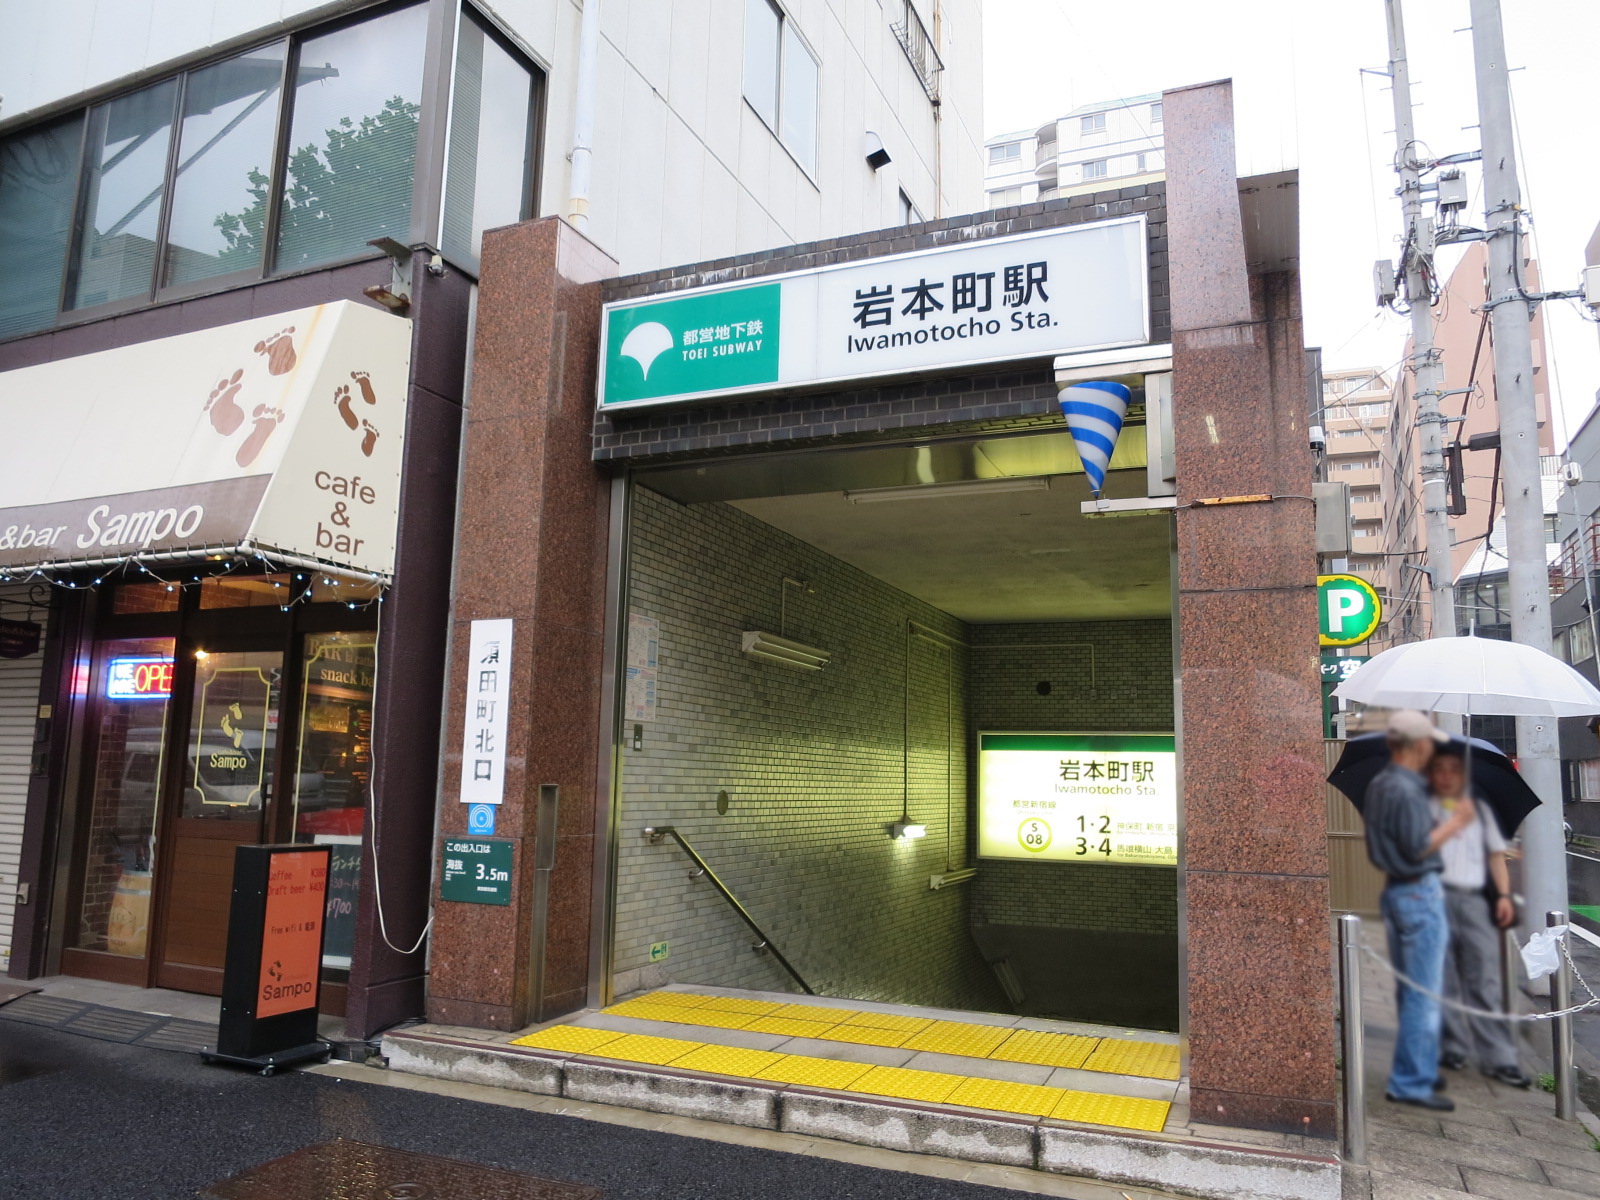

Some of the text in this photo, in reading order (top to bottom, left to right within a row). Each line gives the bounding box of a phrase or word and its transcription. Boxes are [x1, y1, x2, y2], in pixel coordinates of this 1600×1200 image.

[853, 261, 1050, 330] 岩本町駅
[682, 319, 763, 346] 都営地下鉄
[847, 310, 1060, 354] Iwamotocho Sta.
[682, 339, 763, 362] TOEI SUBWAY
[314, 470, 376, 505] cafe
[330, 501, 352, 529] &
[76, 503, 204, 549] Sampo
[315, 522, 365, 557] bar
[1327, 589, 1364, 633] P
[320, 668, 374, 687] snack ba
[473, 640, 501, 782] 須田町北口
[210, 753, 247, 771] Sampo
[1059, 759, 1154, 783] 岩本町駅
[1055, 783, 1160, 796] Iwamotocho Sta.
[1031, 823, 1038, 832] S
[446, 843, 491, 854] この出入口は
[1026, 834, 1043, 845] 08
[1155, 846, 1173, 855] 大島
[268, 869, 292, 882] Coffee
[475, 863, 508, 882] 3.5m
[267, 884, 287, 896] Draft
[289, 884, 306, 895] beer
[262, 981, 312, 1001] Sampo
